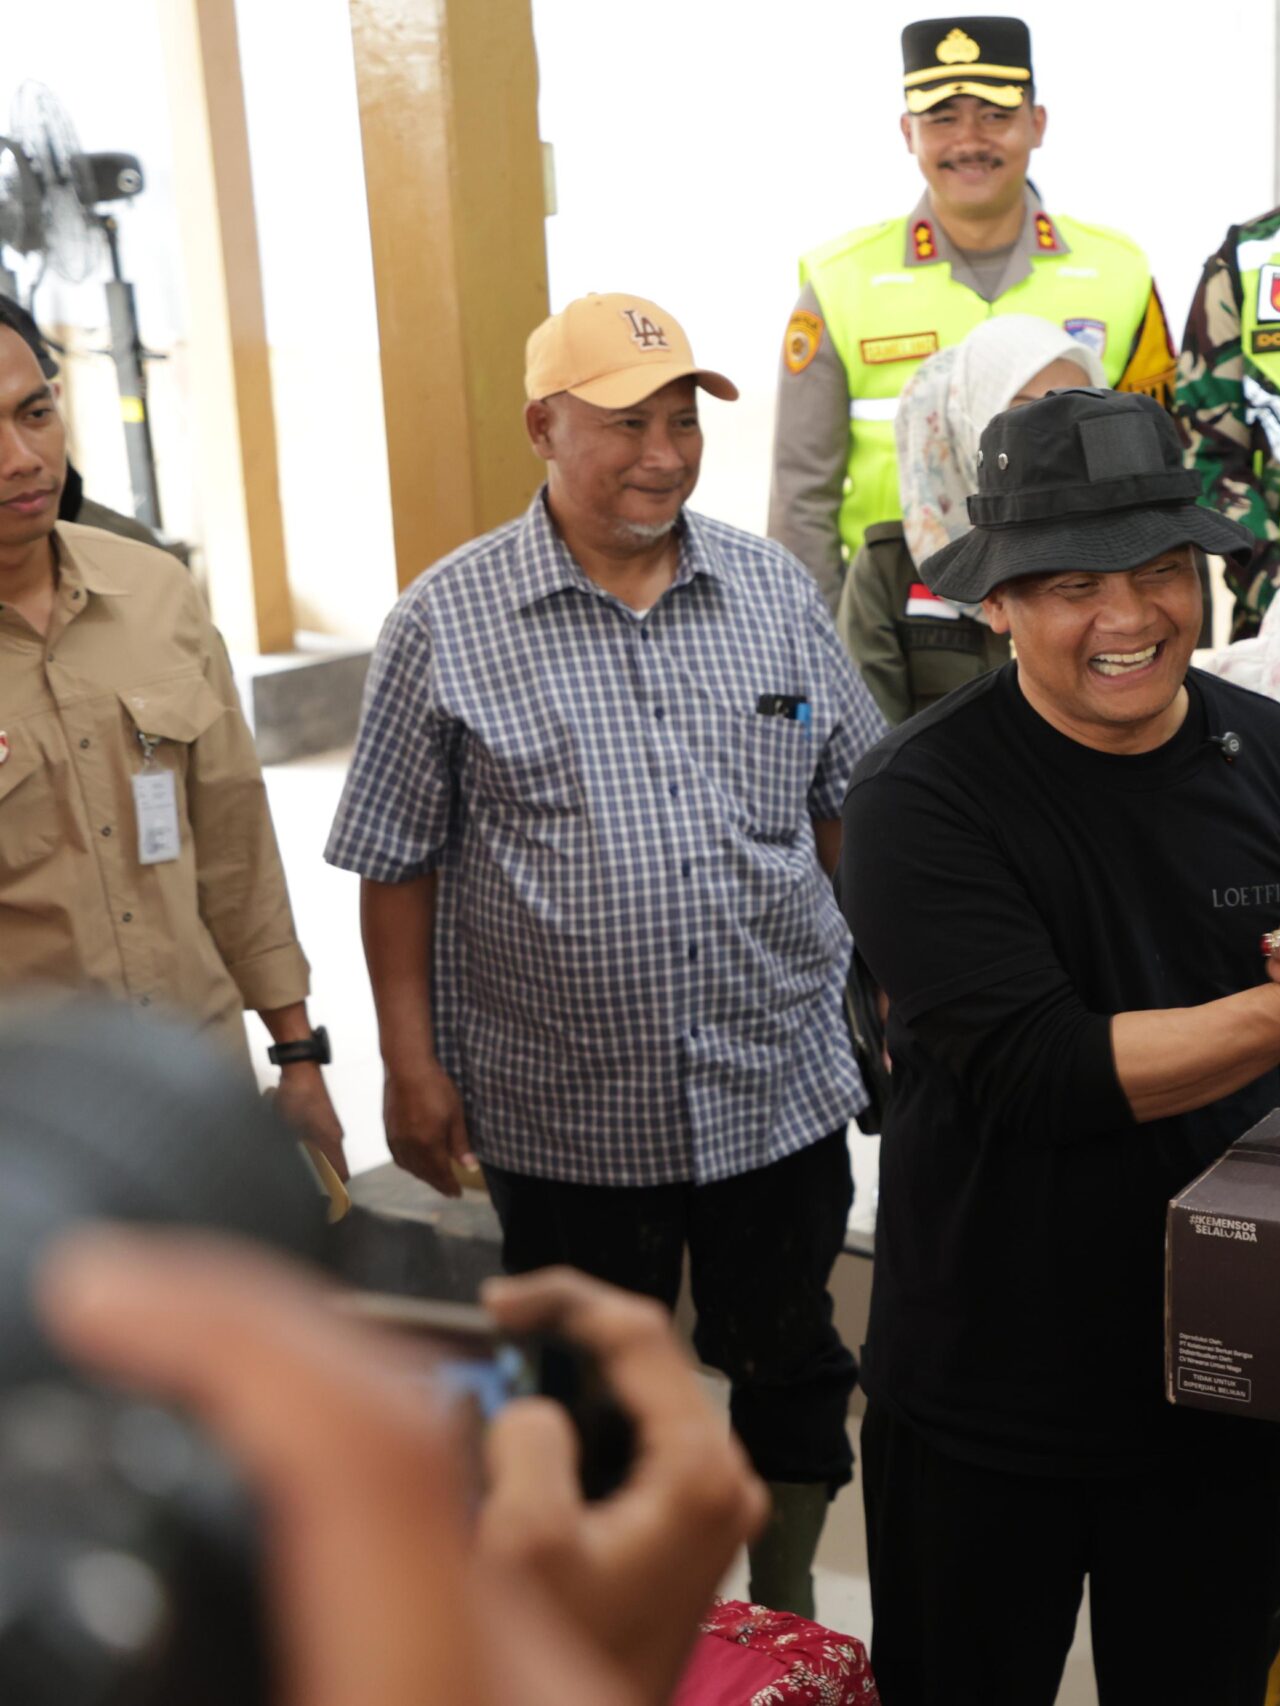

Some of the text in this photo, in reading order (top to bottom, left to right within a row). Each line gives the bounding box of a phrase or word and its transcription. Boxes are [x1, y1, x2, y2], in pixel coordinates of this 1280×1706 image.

[622, 309, 669, 347] LA
[1189, 1214, 1257, 1233] #KEMENSOS
[1193, 1373, 1237, 1388] TIDAK UNTUK
